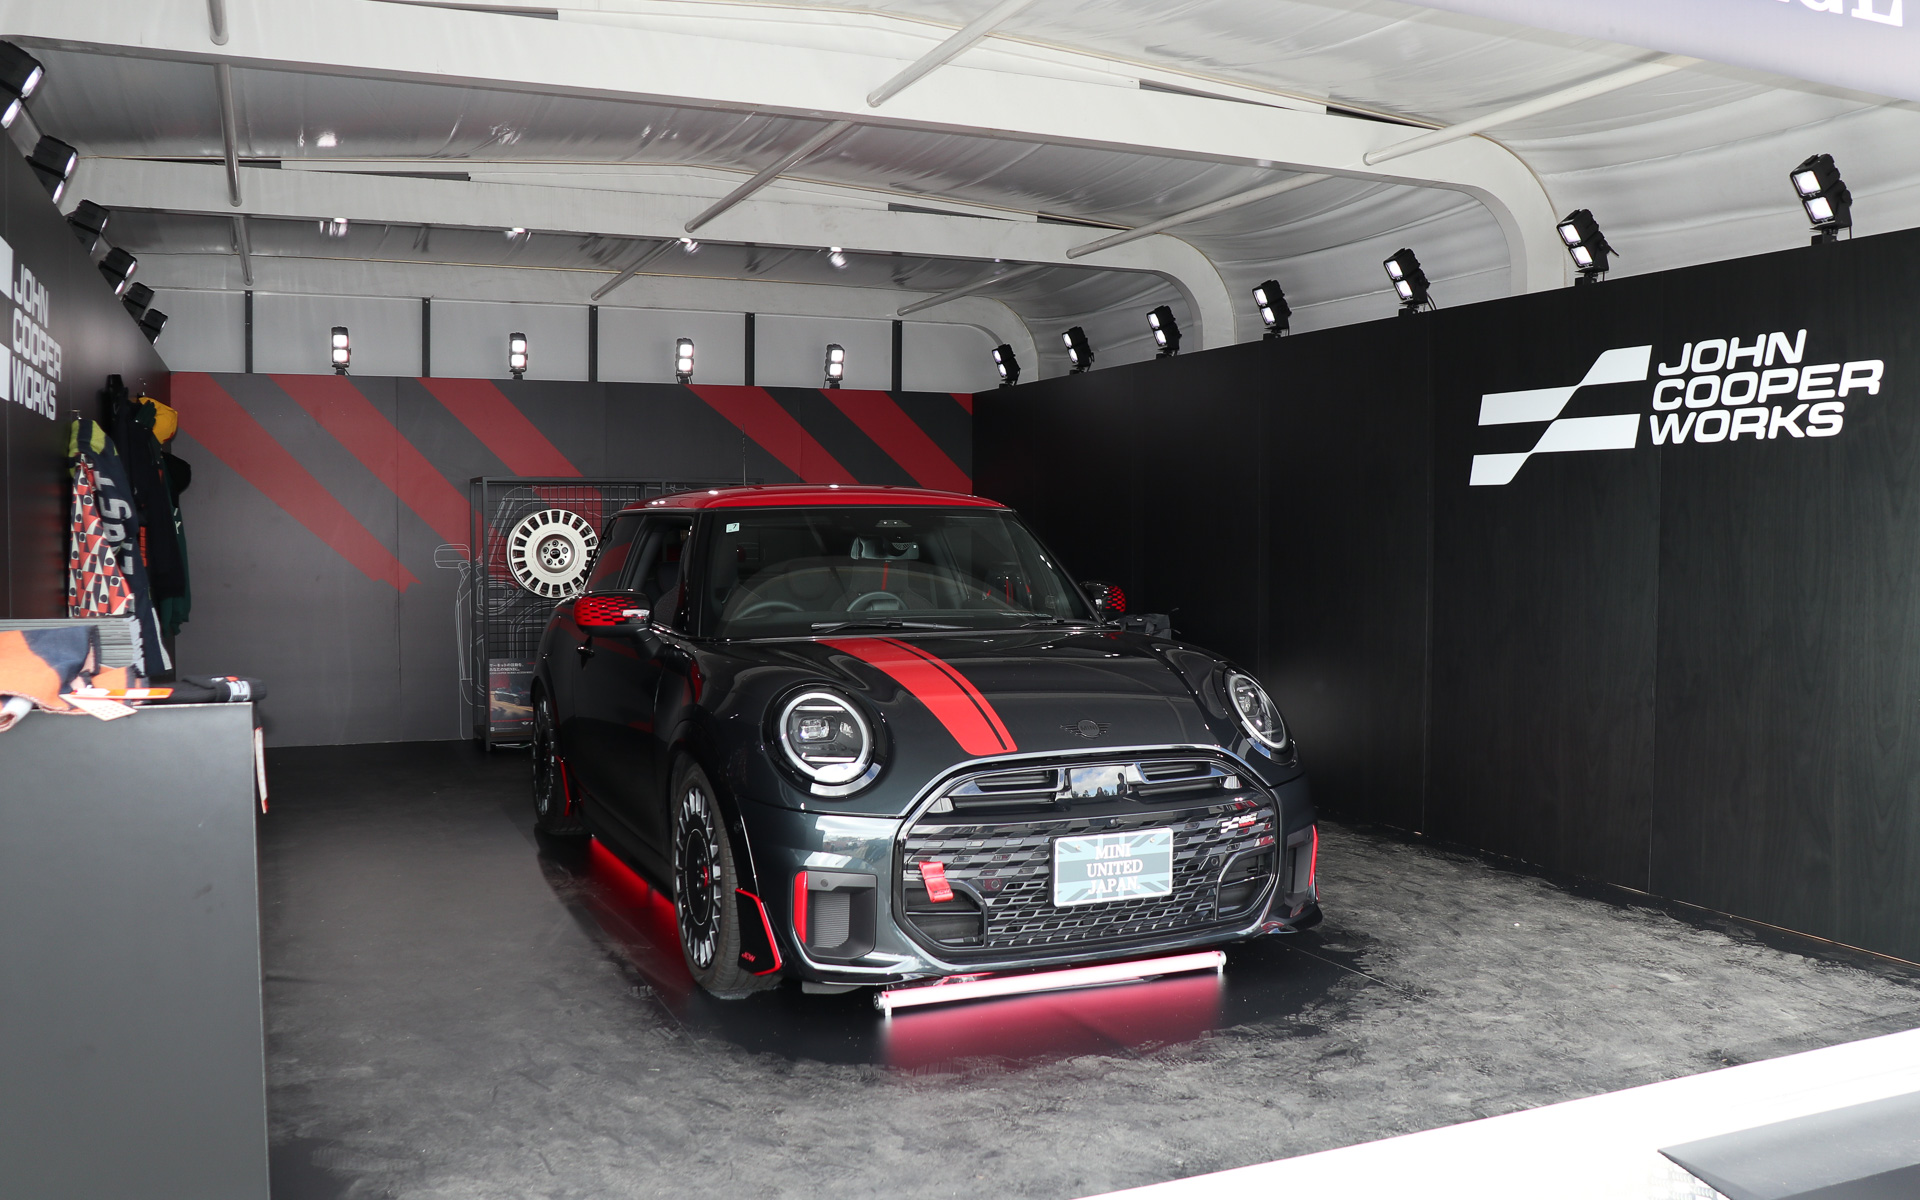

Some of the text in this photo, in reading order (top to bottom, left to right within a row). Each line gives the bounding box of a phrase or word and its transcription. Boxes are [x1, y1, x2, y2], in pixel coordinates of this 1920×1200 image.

[14, 263, 49, 329] JOHN
[12, 307, 62, 382] COOPER
[1657, 328, 1808, 377] JOHN
[12, 356, 57, 421] WORKS
[1652, 358, 1885, 412] COOPER
[1649, 401, 1845, 446] WORKS
[1086, 859, 1144, 878] UNITED
[1094, 843, 1132, 860] MINI
[1087, 875, 1141, 895] JAPAN.
